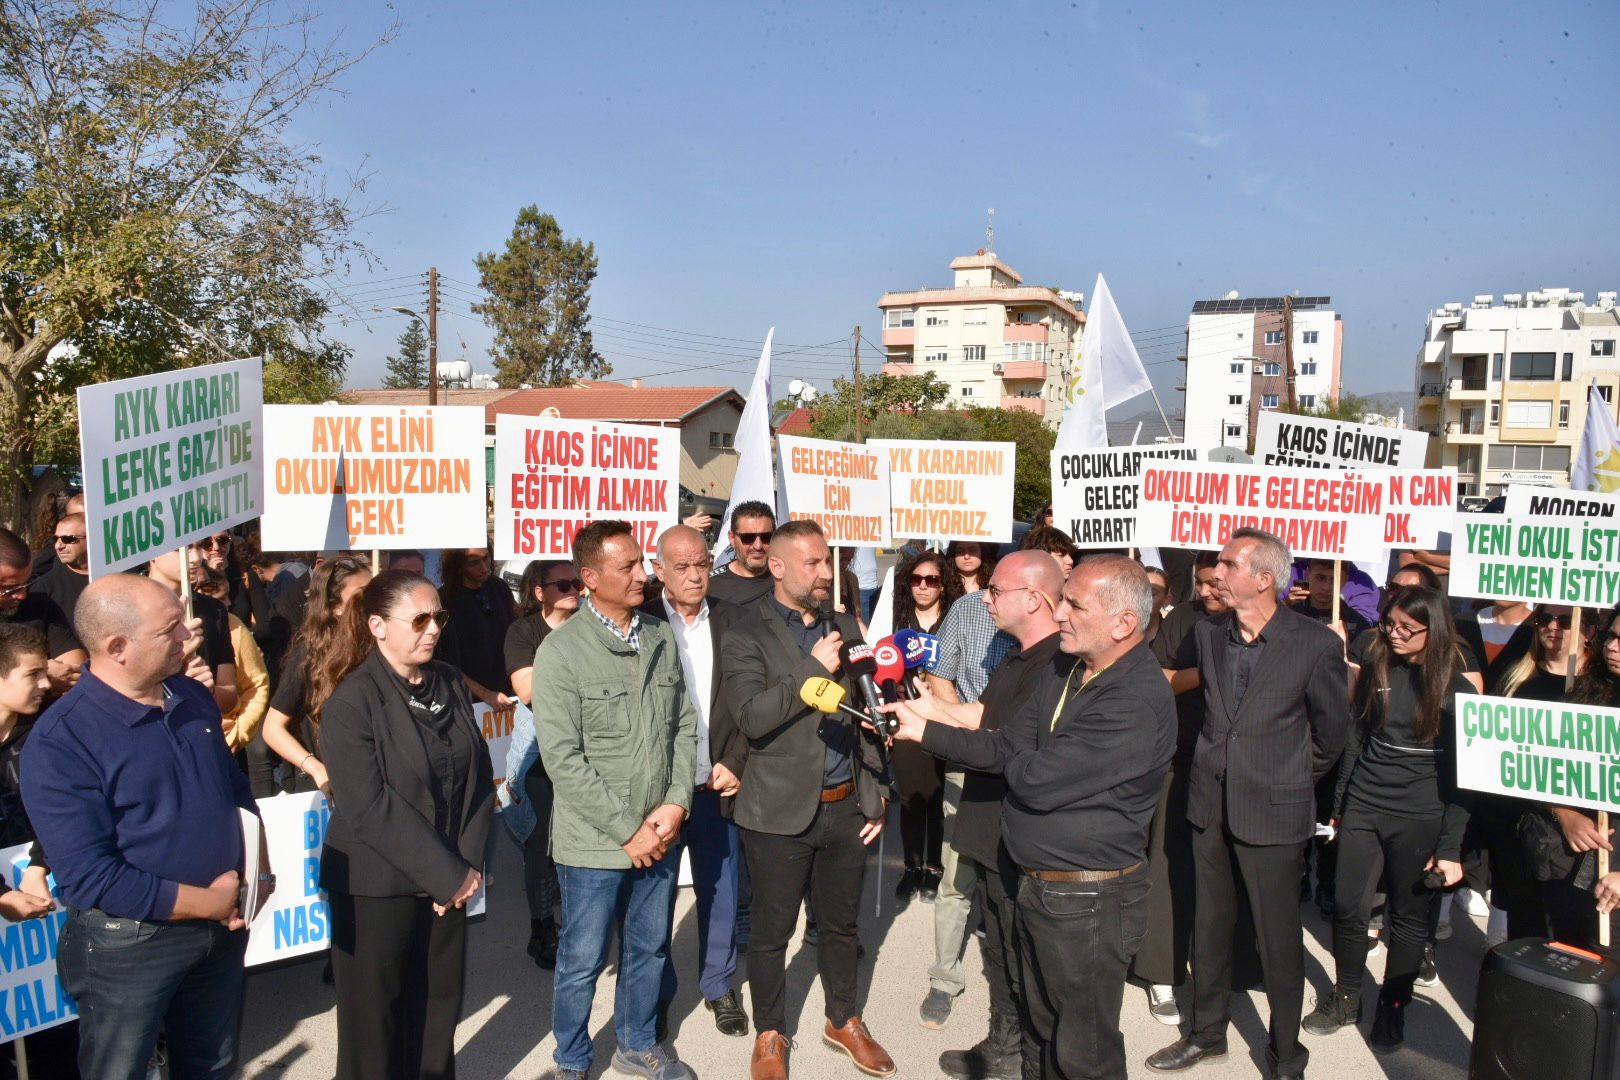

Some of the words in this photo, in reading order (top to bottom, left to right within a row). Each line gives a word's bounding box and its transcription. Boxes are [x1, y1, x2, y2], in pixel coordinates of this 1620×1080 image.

[115, 388, 160, 442] AYK
[166, 371, 241, 429] KARARI
[312, 416, 363, 453] AYK
[371, 408, 434, 453] ELİNİ
[525, 429, 584, 467] KAOS
[592, 426, 658, 472] İÇİNDE
[1277, 423, 1327, 455] KAOS
[1333, 425, 1402, 466] İÇİNDE
[102, 435, 172, 506] LEFKE
[178, 418, 252, 483] GAZİ'DE
[275, 458, 471, 494] OKULUMUZDAN
[792, 446, 878, 480] GELECEĞİMİZ
[889, 448, 911, 473] YK
[918, 448, 1003, 476] KARARINI
[511, 465, 591, 510] EĞİTİM
[597, 476, 667, 512] ALMAK
[824, 479, 851, 513] İÇİN
[910, 478, 968, 505] KABUL
[1144, 468, 1230, 506] OKULUM
[1236, 474, 1260, 508] VE
[1266, 472, 1383, 515] GELECEĞİM
[1410, 475, 1452, 506] CAN
[103, 496, 164, 565] KAOS
[170, 471, 255, 539] YARATTI.
[347, 498, 404, 546] ÇEK!
[892, 504, 992, 536] TMİYORUZ.
[1071, 517, 1136, 543] KARART
[1171, 504, 1213, 546] İÇİN
[1466, 518, 1512, 556] YENİ
[1518, 525, 1574, 560] OKUL
[1581, 521, 1620, 562] İST
[1478, 563, 1553, 599] HEMEN
[1560, 561, 1620, 604] İSTİY
